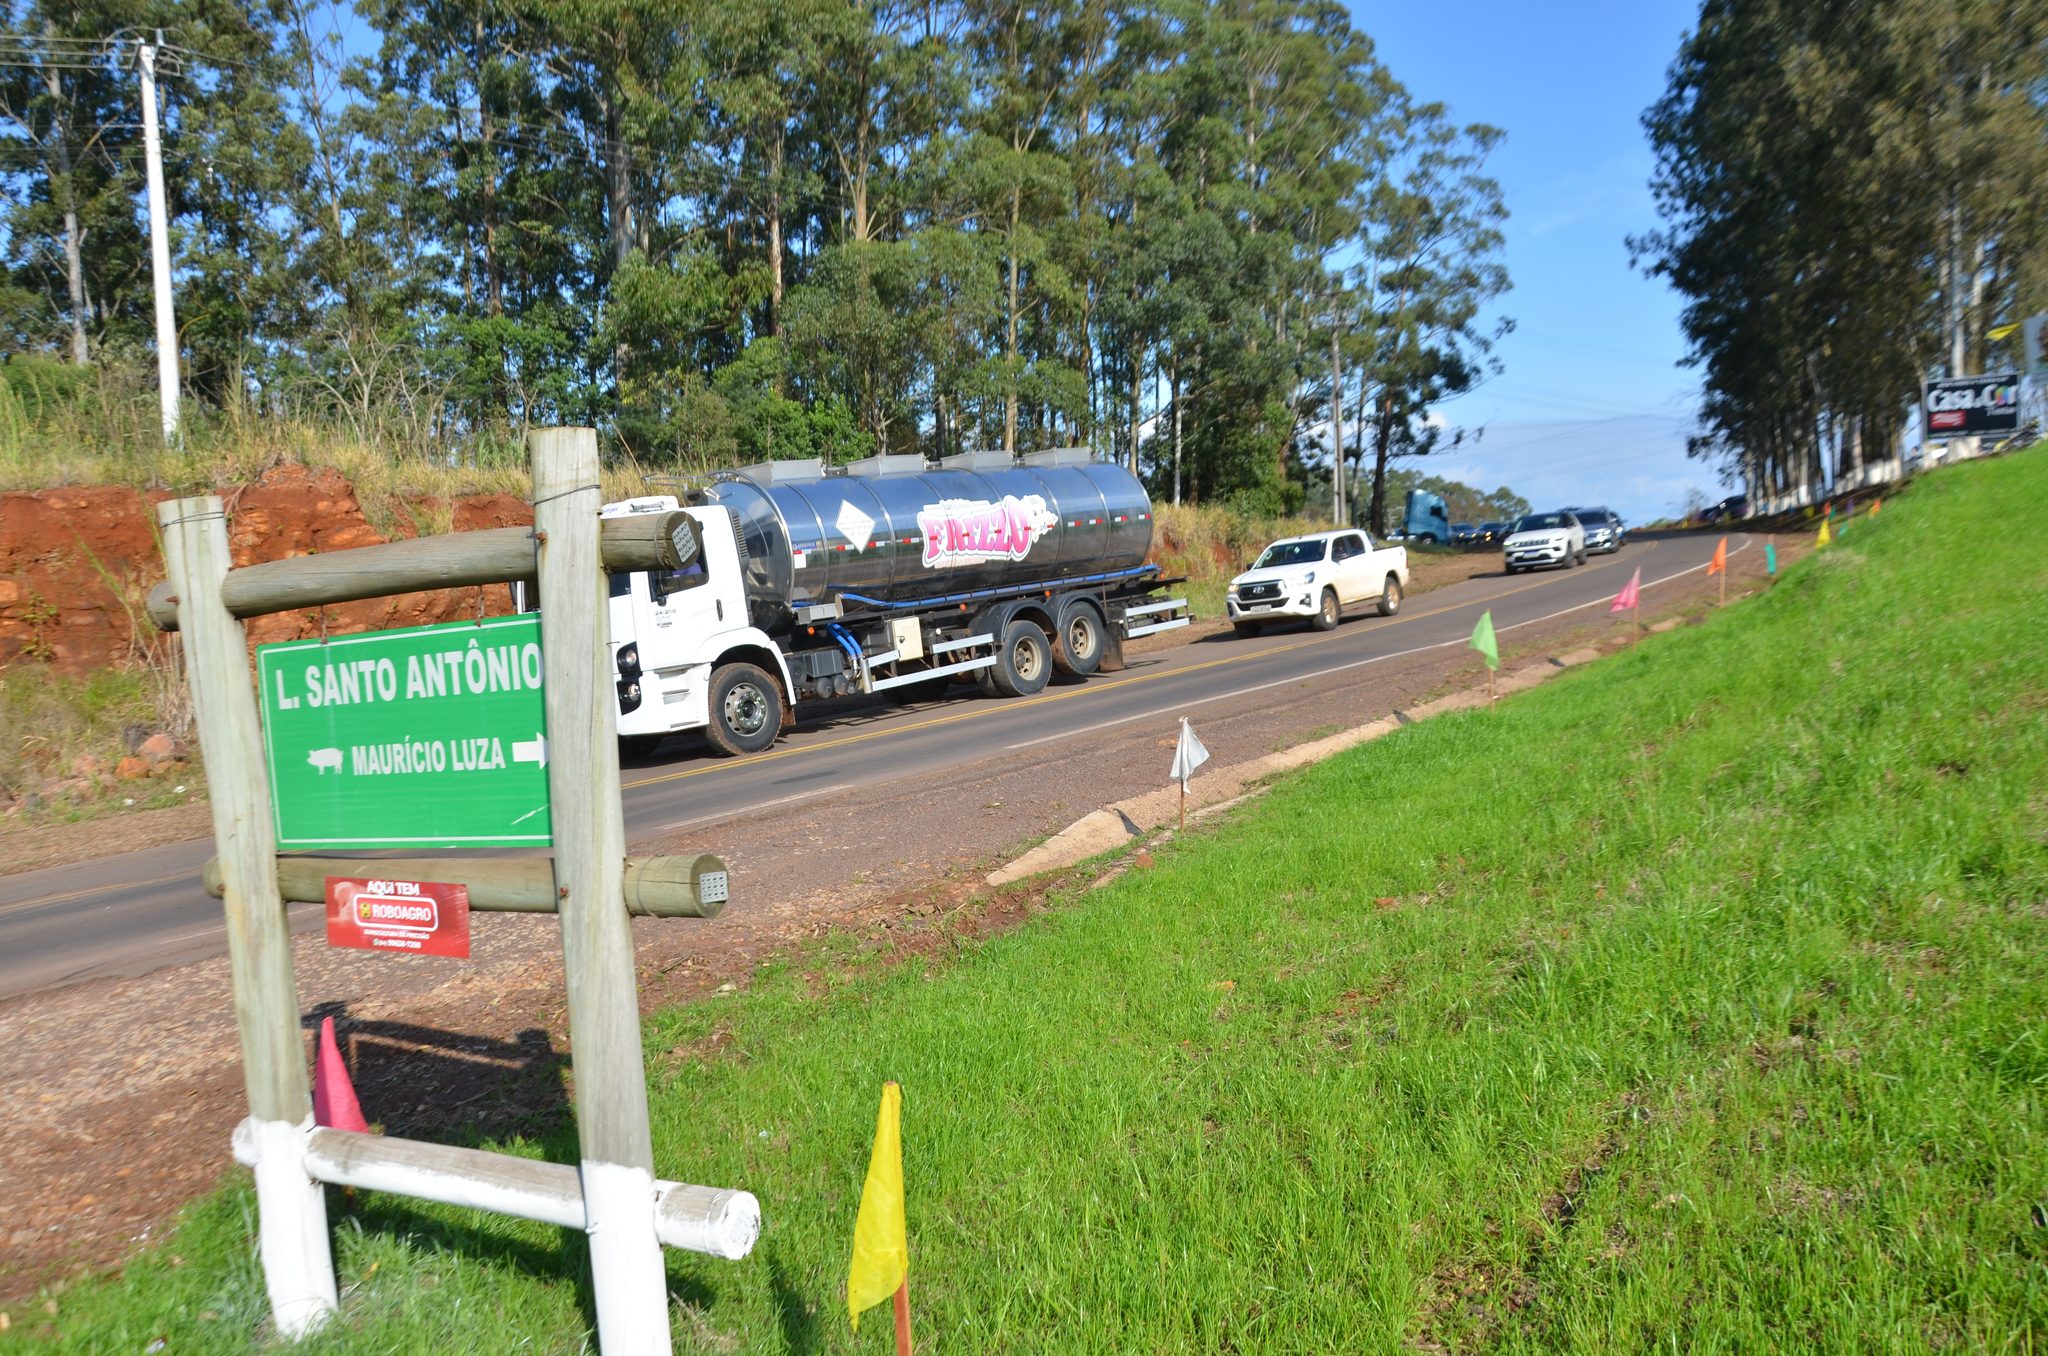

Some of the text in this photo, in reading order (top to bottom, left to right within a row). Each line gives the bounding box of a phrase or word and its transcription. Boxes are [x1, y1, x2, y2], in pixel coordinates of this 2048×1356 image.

[922, 501, 1032, 559] FRIZZO
[275, 638, 545, 710] L. SANTO ANTÔNIO
[351, 735, 506, 776] MAURÍCIO LUZA
[367, 881, 420, 896] AQUI TEM
[371, 903, 432, 922] ROBOAGRO
